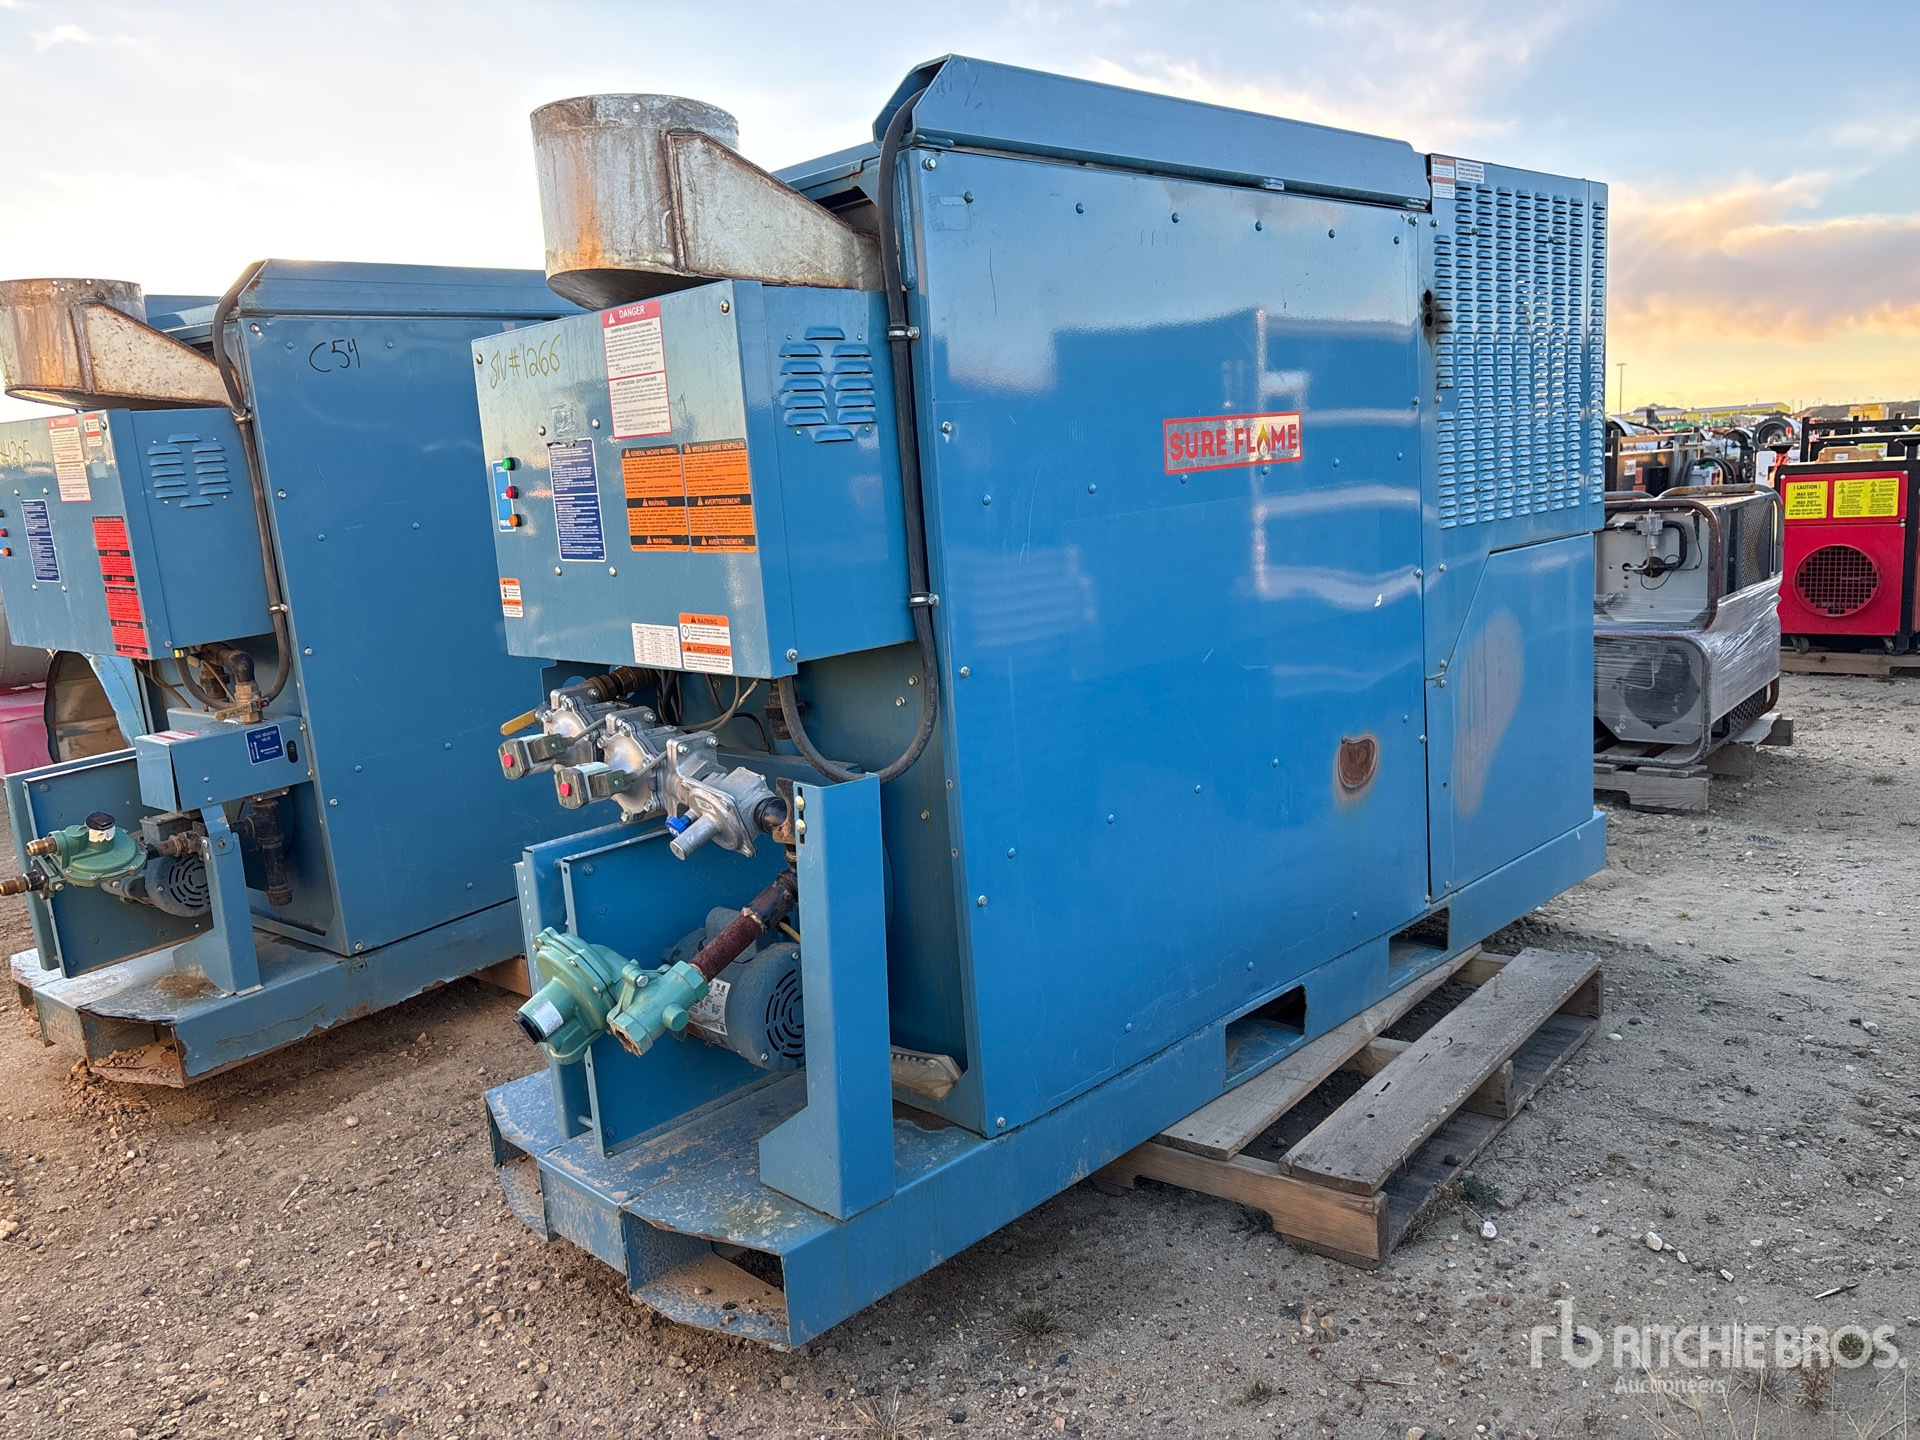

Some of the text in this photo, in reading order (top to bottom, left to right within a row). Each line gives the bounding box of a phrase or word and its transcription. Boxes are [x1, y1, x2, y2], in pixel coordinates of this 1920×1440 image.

[619, 305, 645, 319] DANGER
[309, 338, 360, 373] C54
[1169, 423, 1298, 461] SURE FLAME
[693, 646, 728, 655] AVERTISSEMENT
